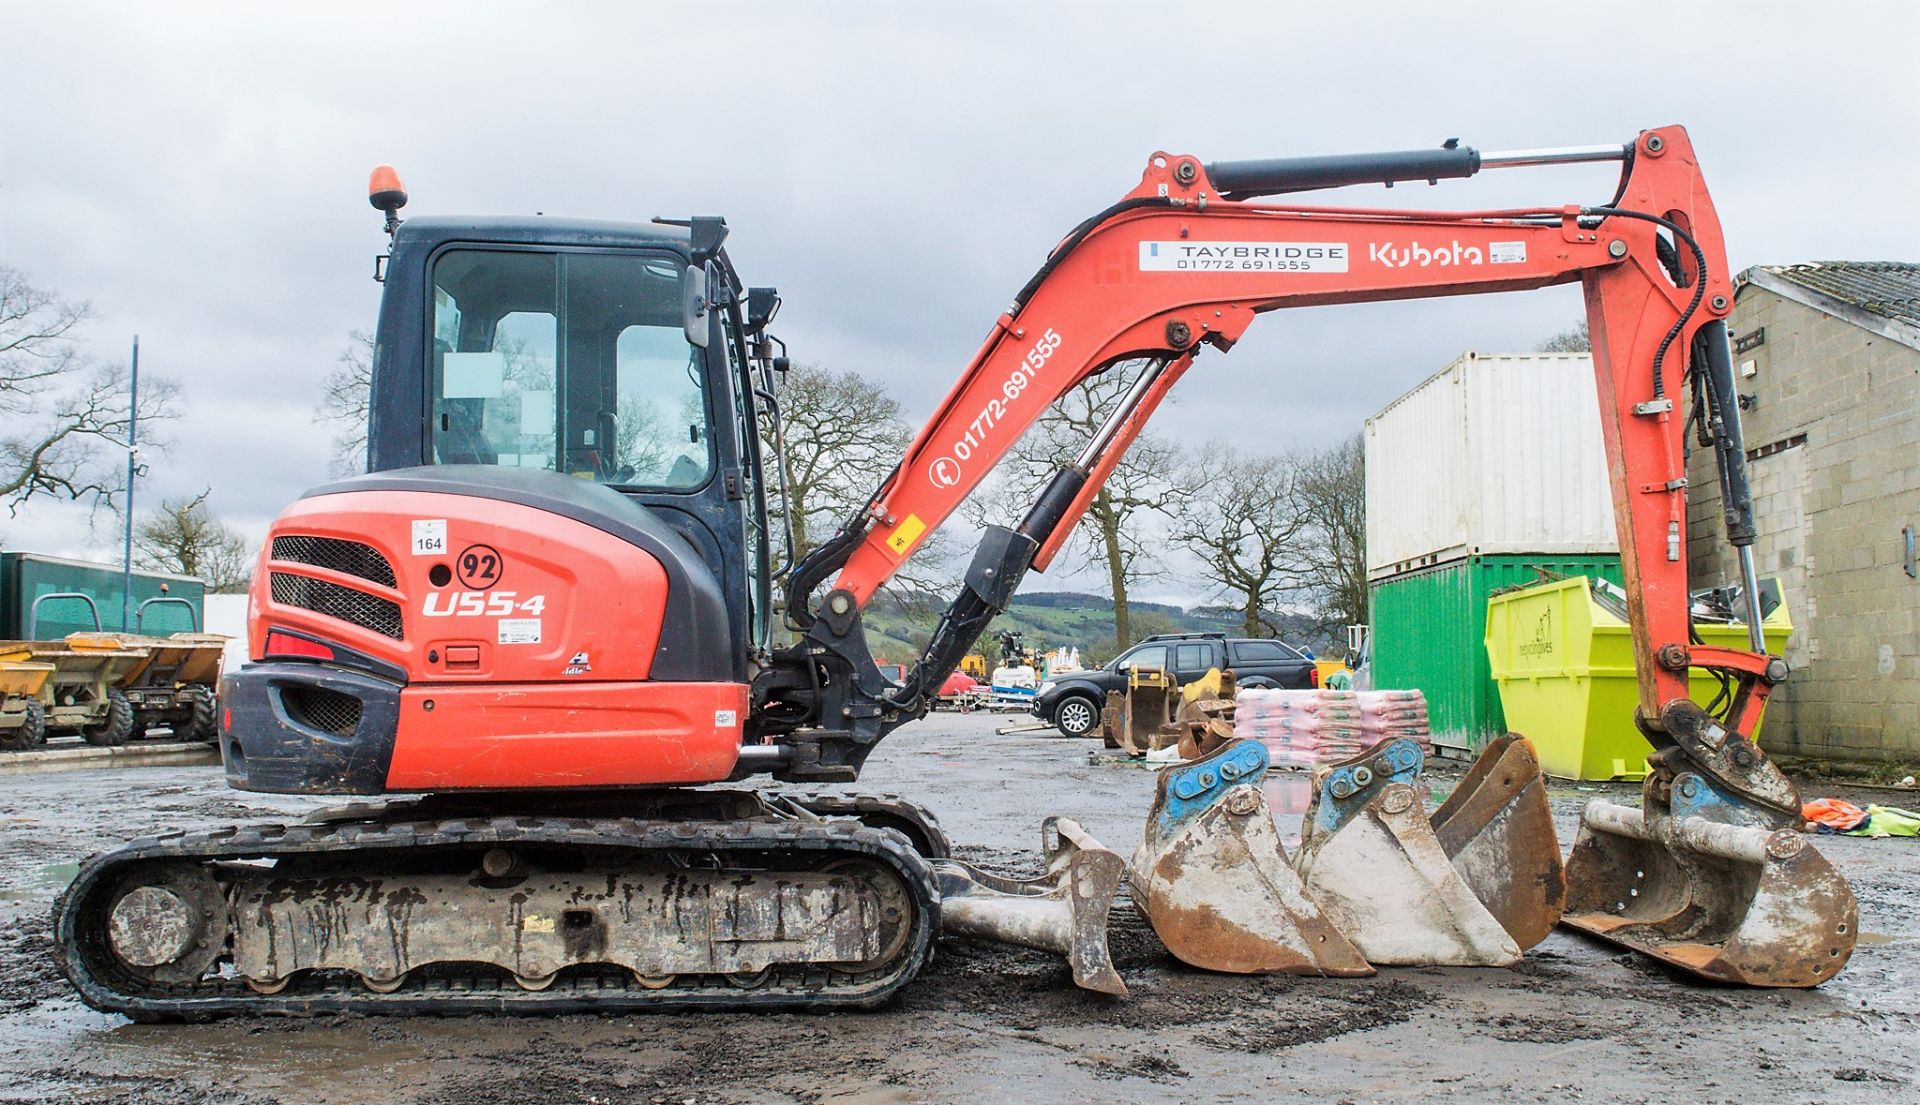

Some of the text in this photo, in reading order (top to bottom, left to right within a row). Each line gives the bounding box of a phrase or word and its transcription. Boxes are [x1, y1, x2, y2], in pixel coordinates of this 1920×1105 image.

[1180, 247, 1343, 259] TAYBRIDGE
[1369, 240, 1483, 268] Kubota
[1177, 260, 1311, 270] 01772 691555
[953, 328, 1062, 461] 01772-691555
[417, 538, 442, 550] 164
[463, 553, 496, 579] 92
